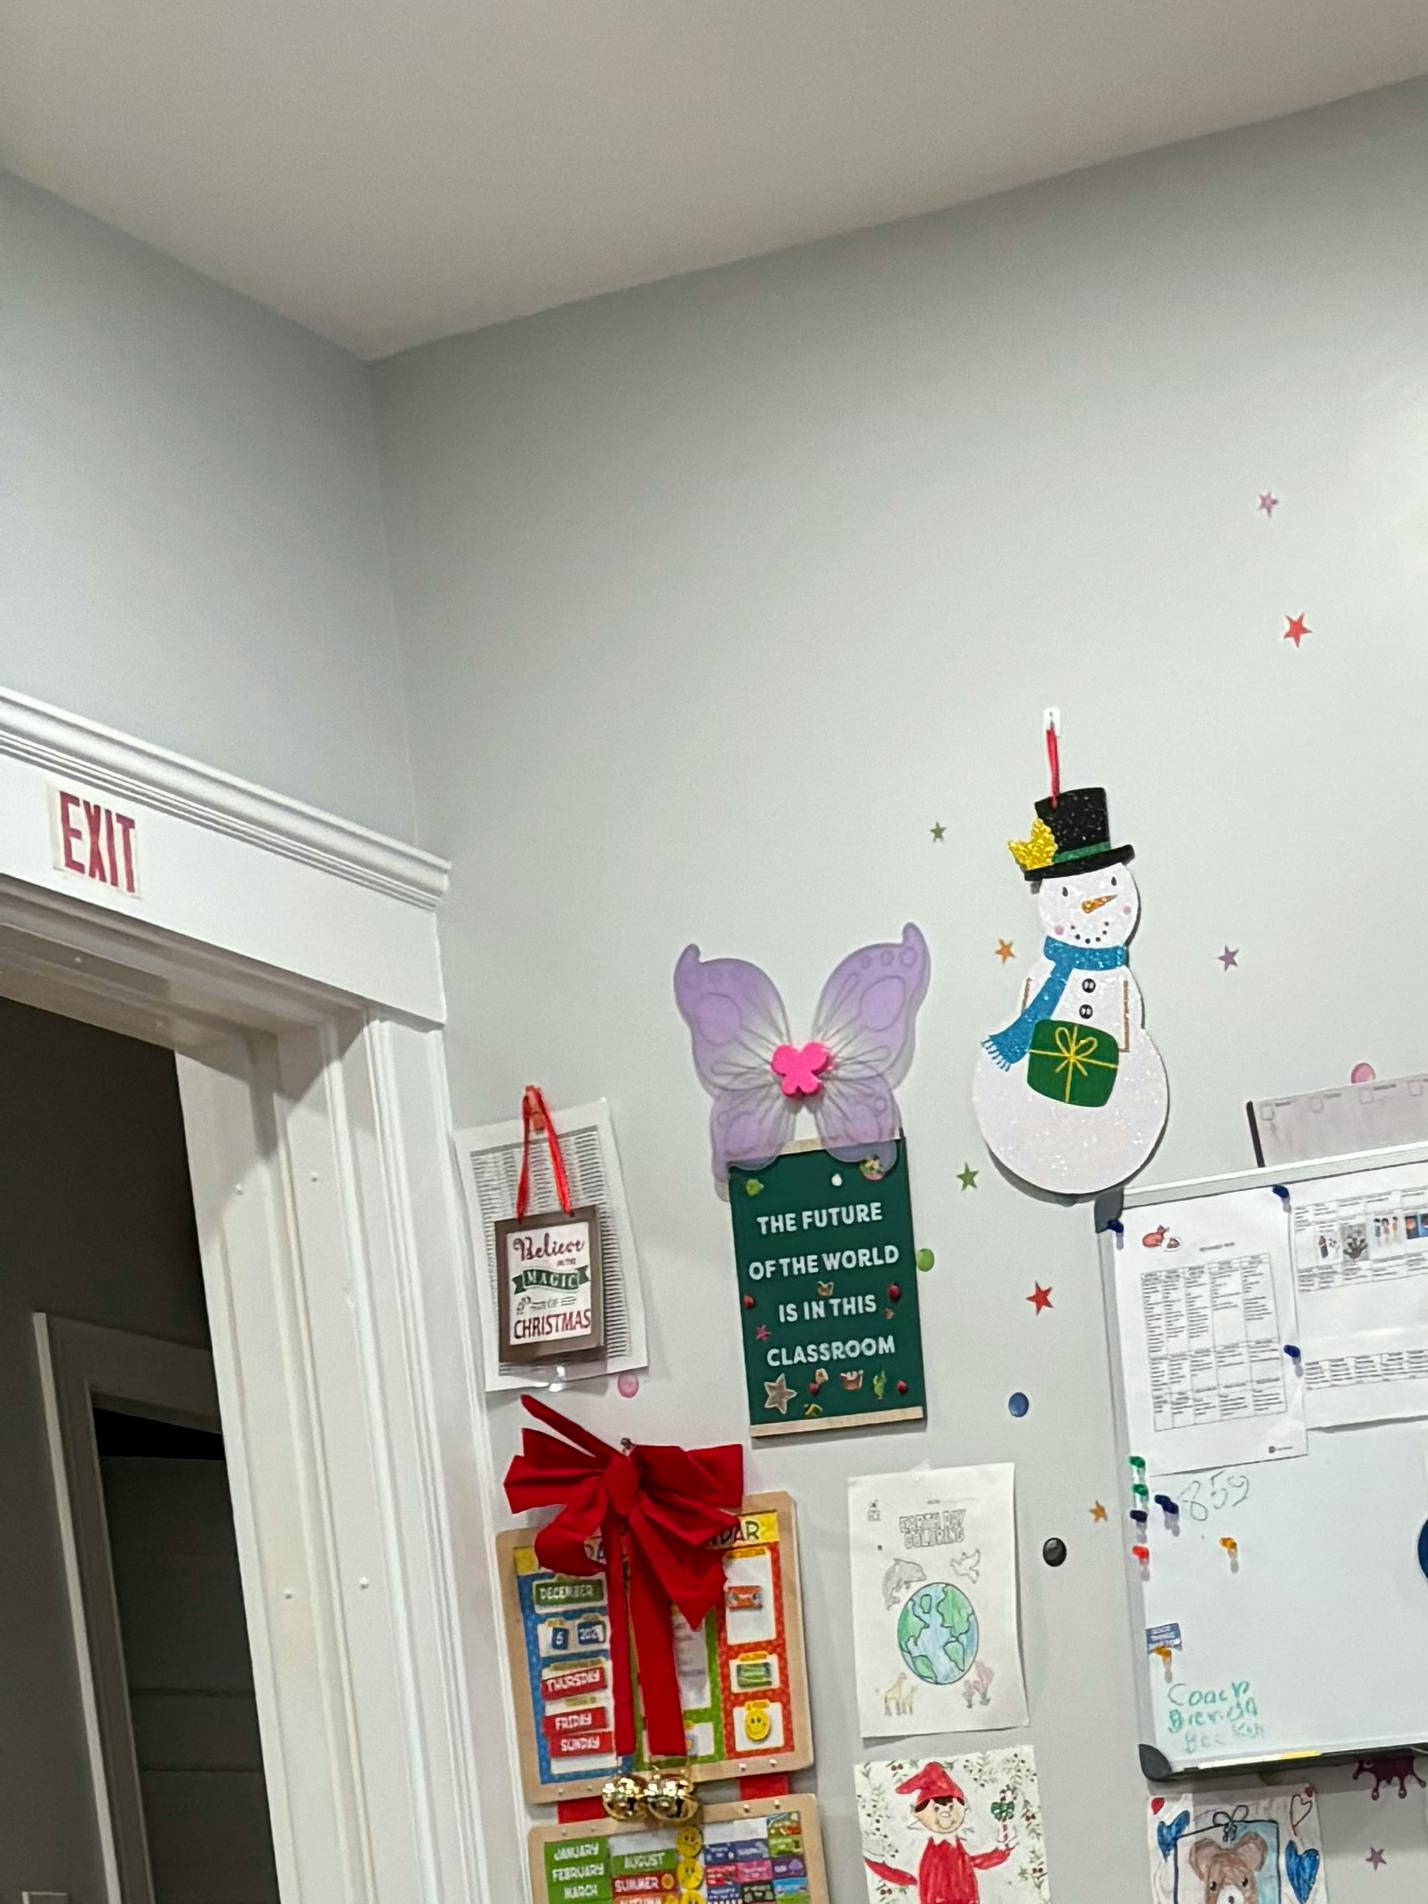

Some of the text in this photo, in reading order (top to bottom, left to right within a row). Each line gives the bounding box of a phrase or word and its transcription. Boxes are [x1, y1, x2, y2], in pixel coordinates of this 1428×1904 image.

[59, 790, 136, 893] EXIT
[757, 1202, 882, 1235] THE FUTURE
[512, 1233, 585, 1261] Believe
[749, 1245, 899, 1281] OF THE WORLD
[525, 1269, 579, 1288] MAGIC
[778, 1294, 877, 1323] IS IN THIS
[513, 1308, 591, 1339] CHRISTMAS
[767, 1335, 895, 1367] CLASSROOM
[539, 1584, 594, 1600] DECEMBER
[546, 1668, 600, 1691] THURSDAY
[555, 1713, 592, 1730] FRIDAY
[560, 1735, 600, 1752] SUNDAY
[554, 1843, 599, 1861] JANUARY
[624, 1852, 665, 1869] AUGUST
[552, 1864, 605, 1882] FEBRUARY
[564, 1884, 598, 1899] MARCH
[615, 1876, 659, 1892] SUMMER
